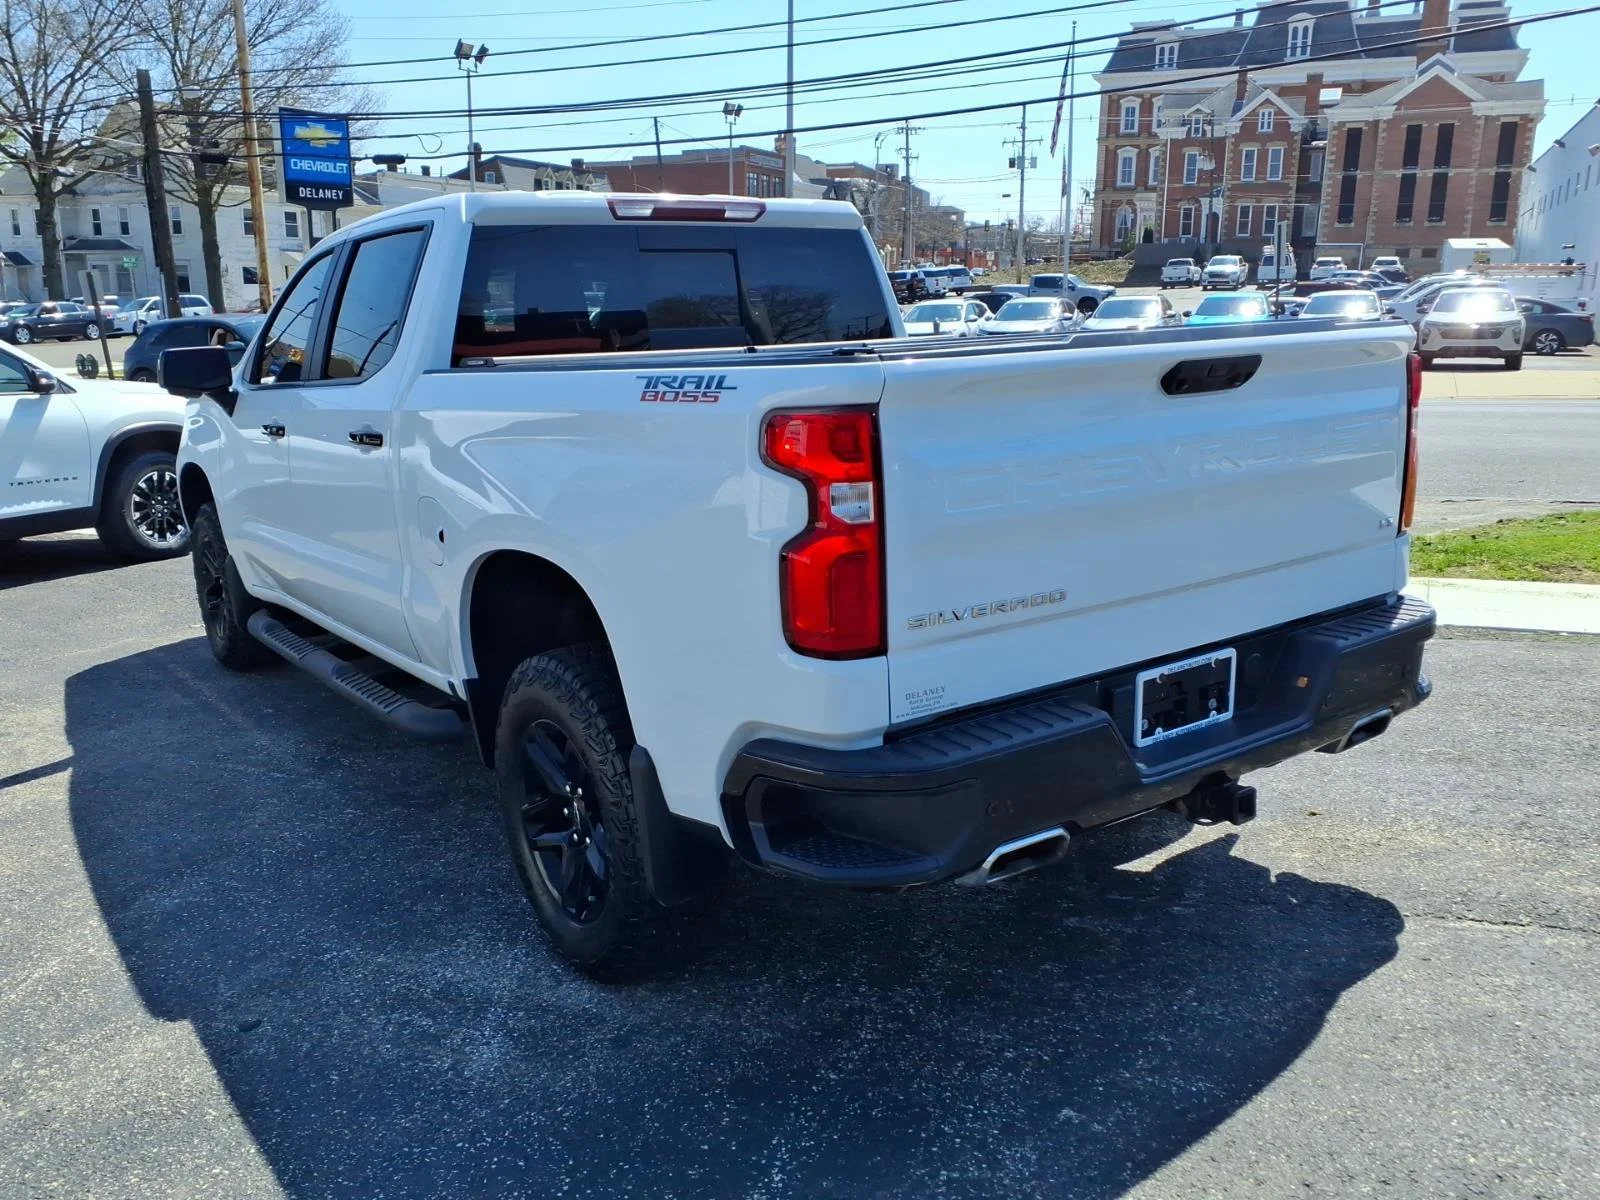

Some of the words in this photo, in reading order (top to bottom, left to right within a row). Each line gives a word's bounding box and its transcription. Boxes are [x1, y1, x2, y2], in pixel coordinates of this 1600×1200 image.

[290, 158, 349, 174] CHEVROLET
[299, 186, 344, 200] DELANEY
[635, 374, 738, 390] TRAIL
[639, 390, 723, 403] BOSS
[9, 476, 79, 487] TRAVERSE
[907, 588, 1067, 630] SILVERADO
[905, 686, 946, 700] DELANEY
